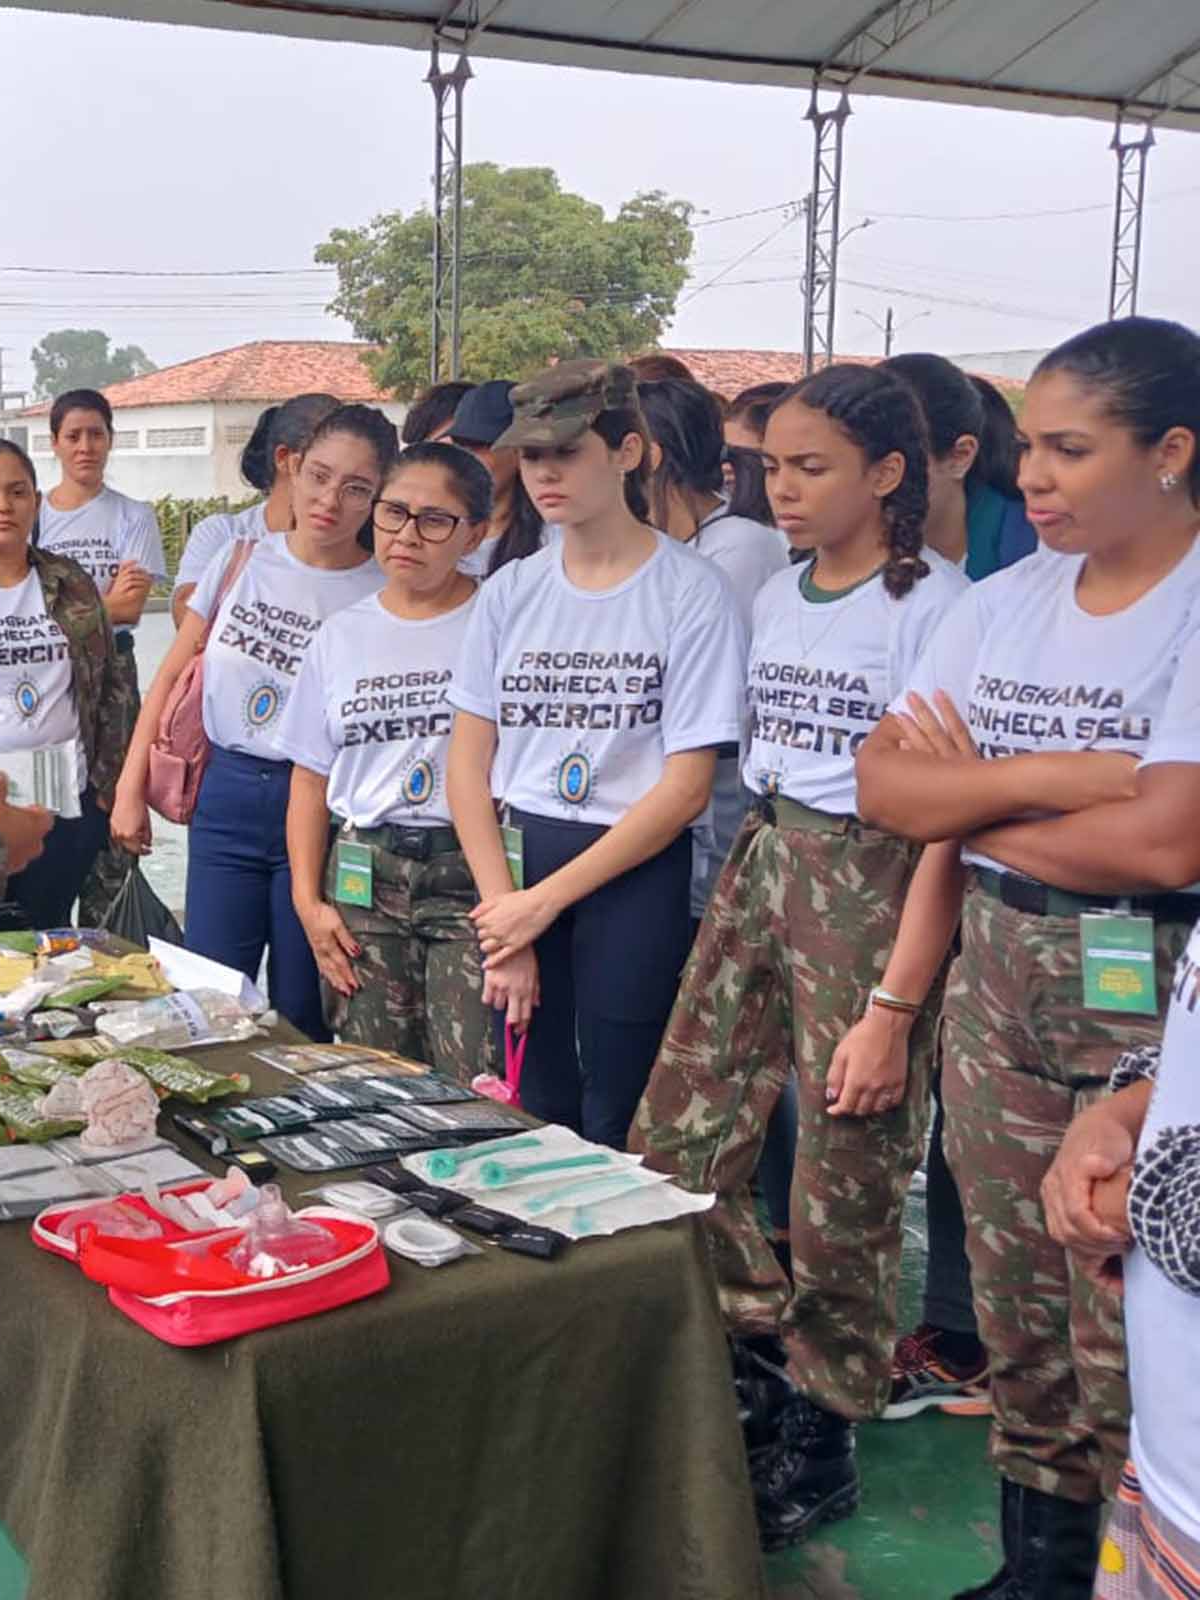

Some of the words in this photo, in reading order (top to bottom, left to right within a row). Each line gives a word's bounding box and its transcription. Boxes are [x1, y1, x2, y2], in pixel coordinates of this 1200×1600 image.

[519, 651, 662, 670] PROGRAMA
[501, 674, 618, 698] CONHEÇA
[752, 661, 870, 695] ROGRAMA
[499, 696, 664, 730] EXÉRCITO
[968, 702, 1067, 744] ONHEÇA
[1075, 716, 1151, 741] SEU
